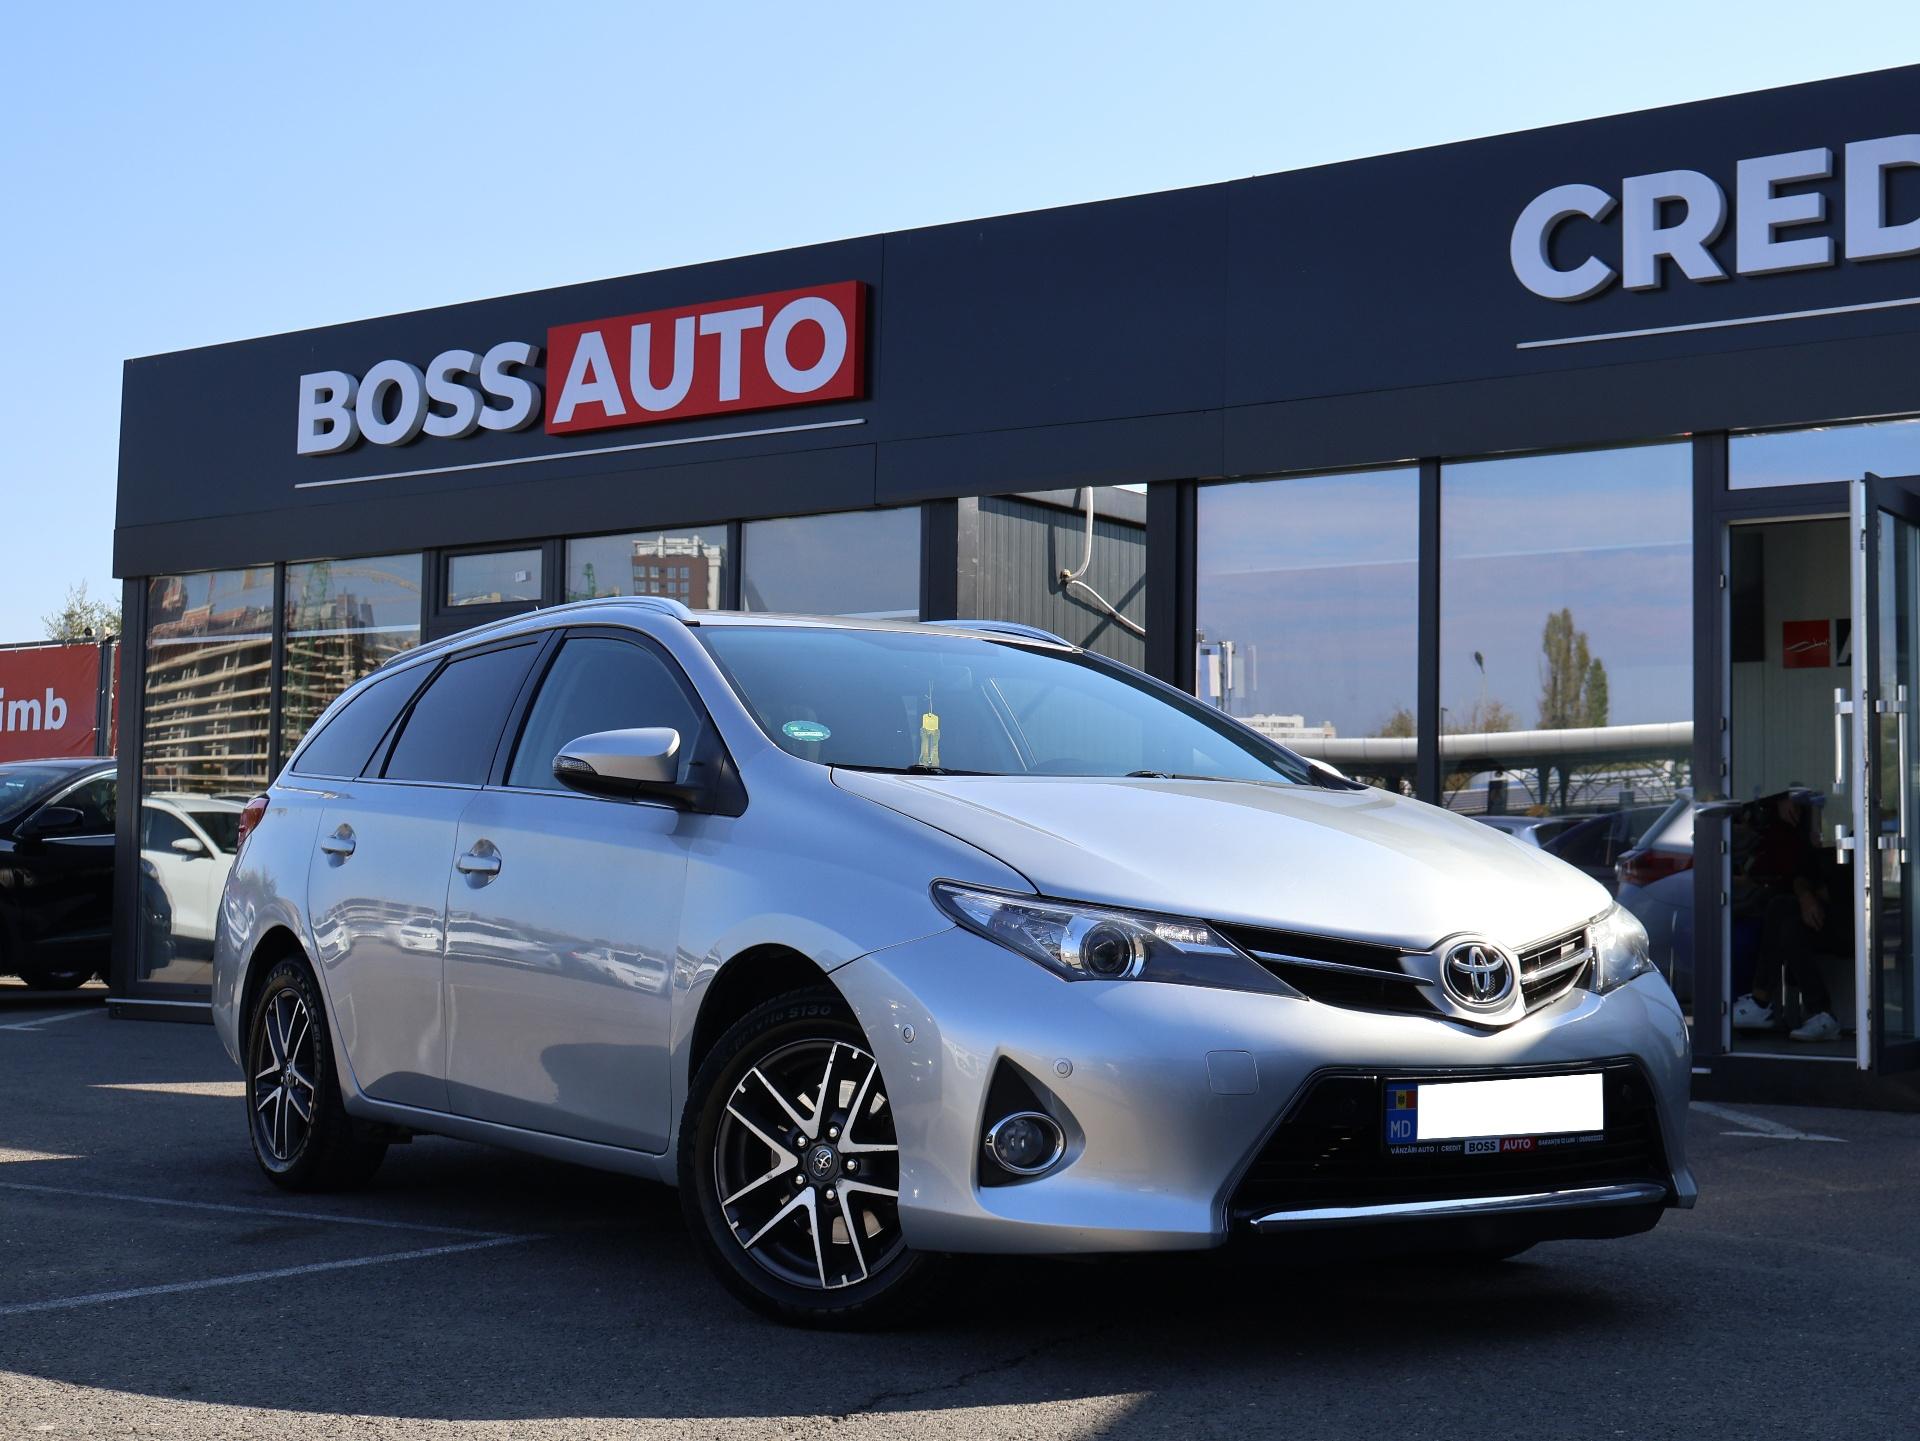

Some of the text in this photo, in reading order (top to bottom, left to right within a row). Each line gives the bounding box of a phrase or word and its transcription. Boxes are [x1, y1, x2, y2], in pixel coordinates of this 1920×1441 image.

[1510, 134, 1920, 301] CRED
[297, 296, 847, 455] BOSS AUTO
[1390, 1120, 1411, 1138] MD
[1441, 1144, 1461, 1152] CREDIT
[1468, 1138, 1531, 1152] BOSS AUTO
